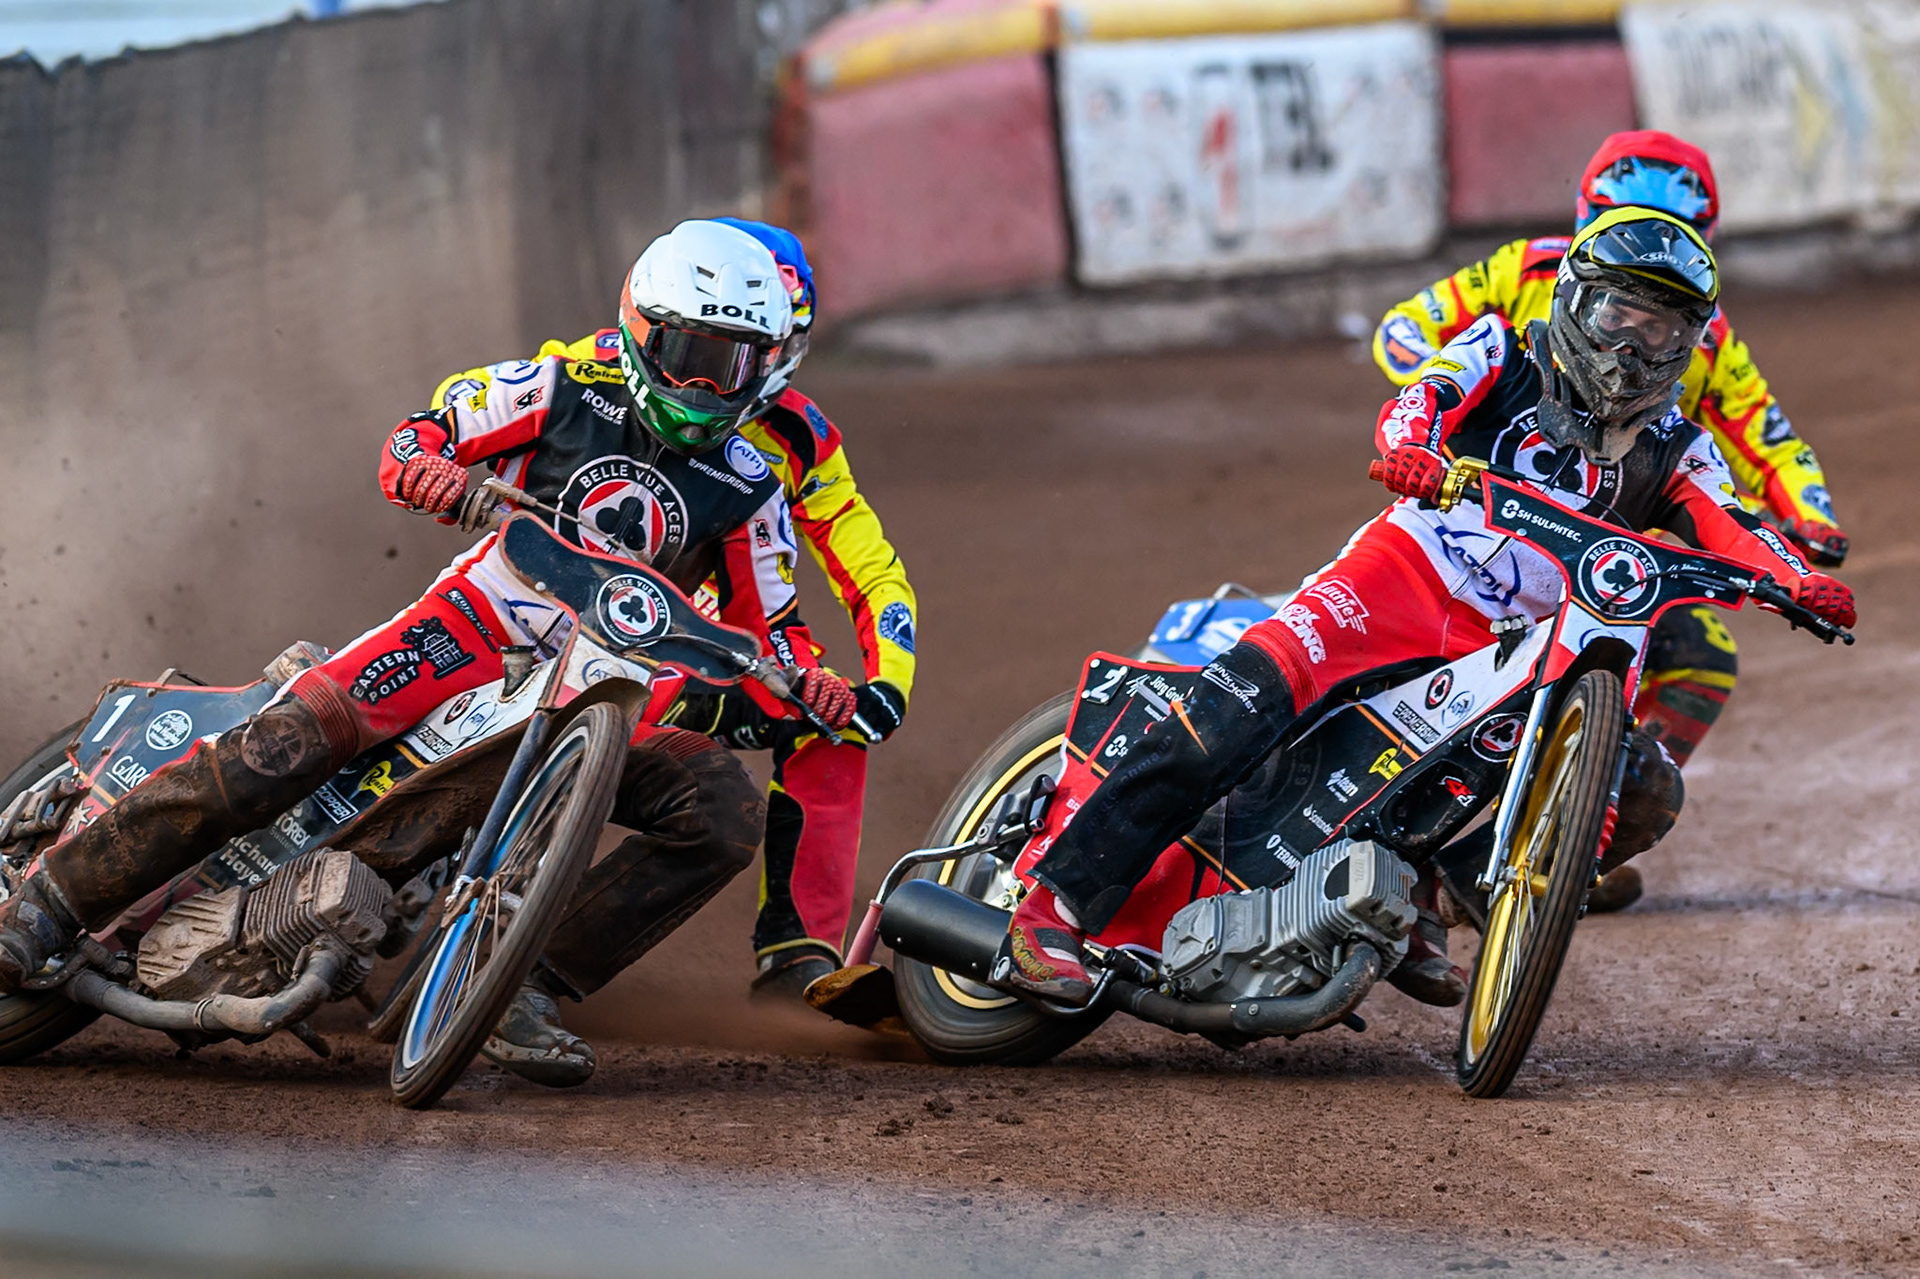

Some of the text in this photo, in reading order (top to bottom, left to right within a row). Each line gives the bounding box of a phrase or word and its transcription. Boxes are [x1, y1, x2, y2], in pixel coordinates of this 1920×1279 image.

[701, 304, 770, 330] BOLL
[618, 332, 650, 410] OLL
[581, 388, 628, 420] ROWE
[734, 444, 763, 470] ATPI
[693, 461, 754, 495] PREMIERSHIP
[580, 464, 681, 544] BELLE VUE ACES
[1517, 509, 1532, 521] SH
[1588, 542, 1616, 561] BELLE
[1620, 543, 1640, 556] VUE
[1641, 557, 1656, 575] ACE
[637, 580, 654, 595] VUE
[354, 651, 420, 698] EASTERN
[369, 666, 418, 701] POINT
[1092, 669, 1120, 699] 2
[1150, 676, 1169, 697] Jörg
[91, 694, 136, 742] 1
[220, 848, 262, 885] Haye
